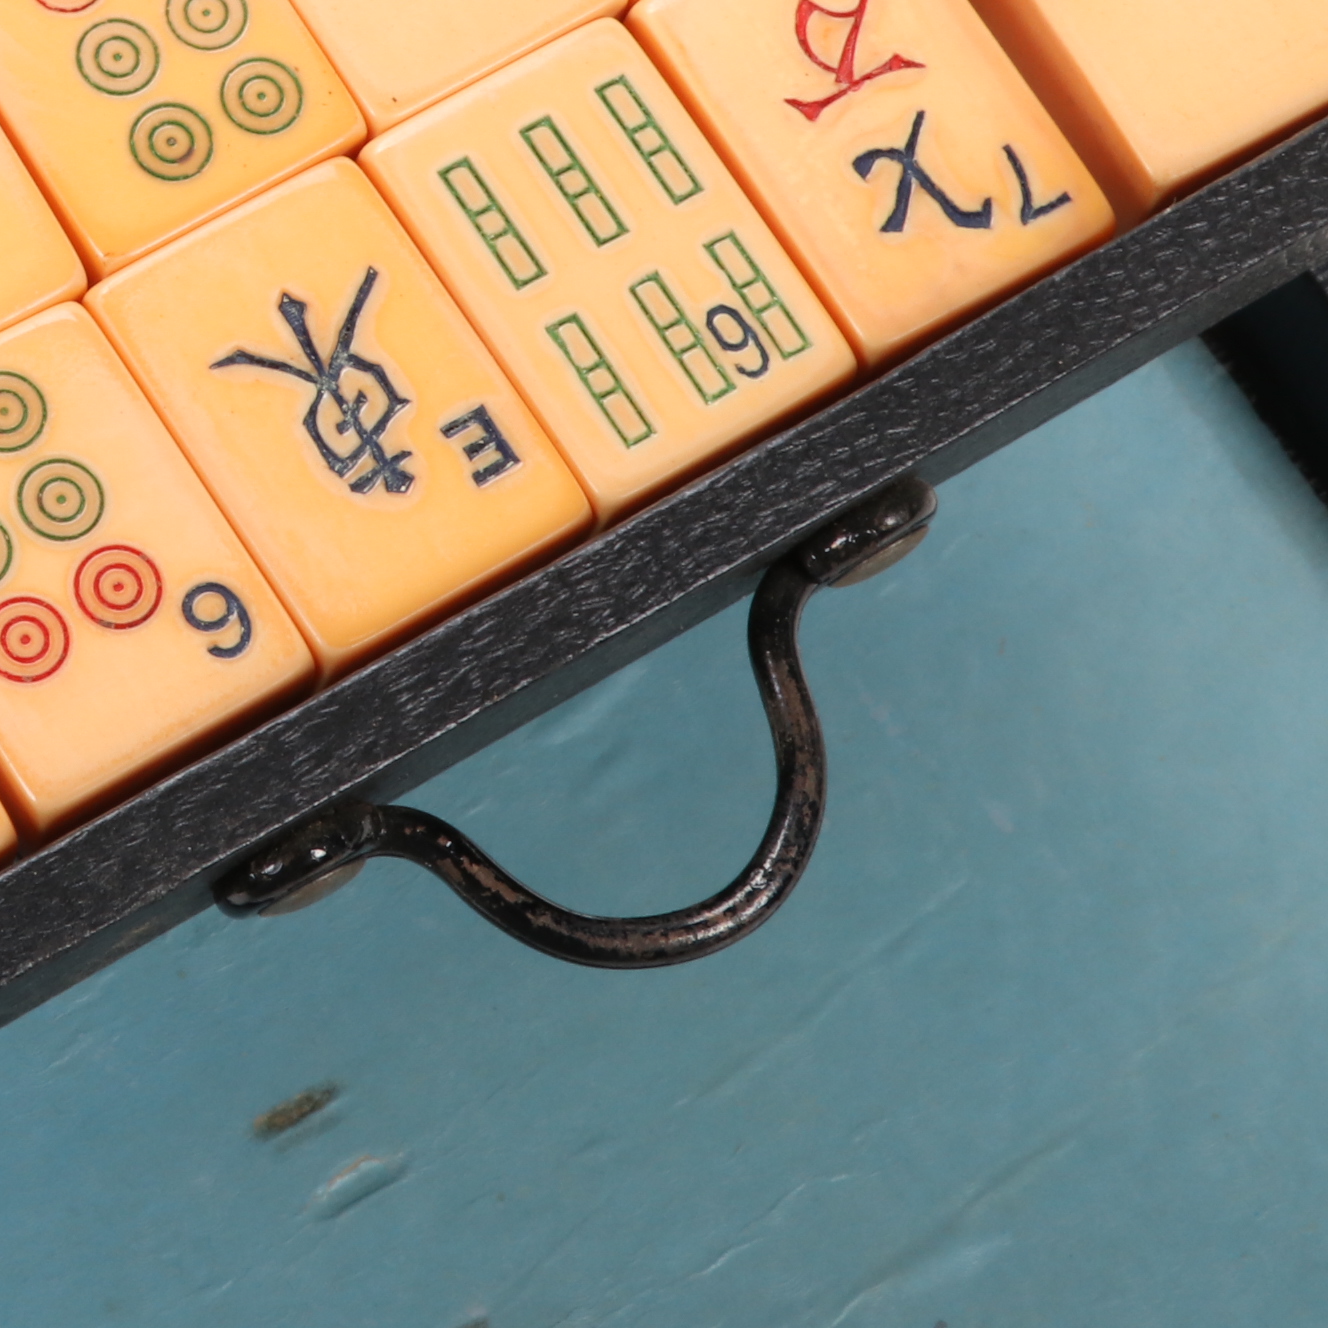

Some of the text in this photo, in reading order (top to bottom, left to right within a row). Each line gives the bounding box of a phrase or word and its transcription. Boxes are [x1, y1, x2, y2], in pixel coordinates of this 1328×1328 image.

[1002, 144, 1073, 226] 7
[208, 265, 416, 495] 東
[439, 403, 522, 488] E
